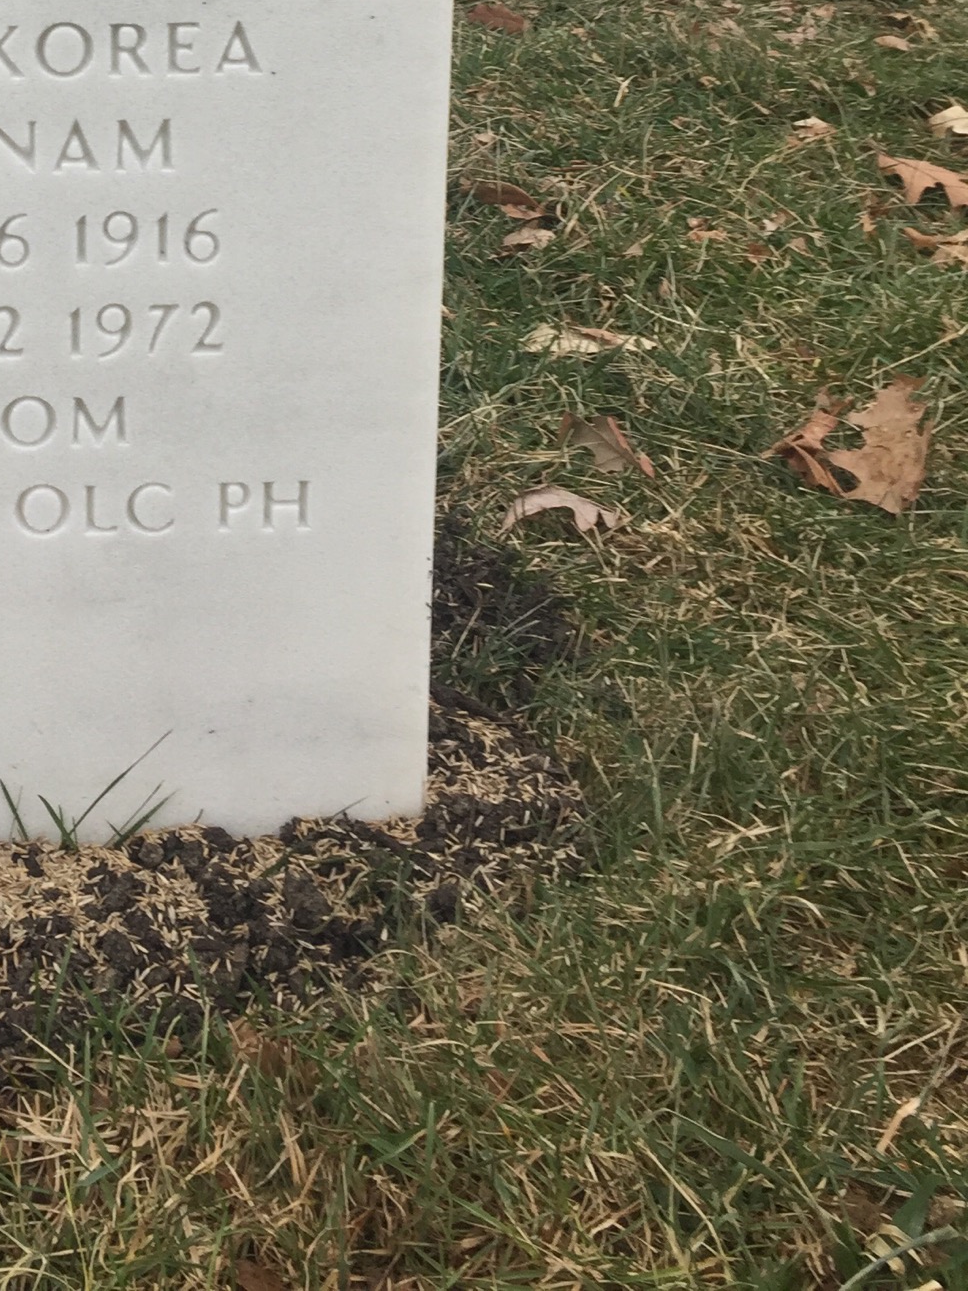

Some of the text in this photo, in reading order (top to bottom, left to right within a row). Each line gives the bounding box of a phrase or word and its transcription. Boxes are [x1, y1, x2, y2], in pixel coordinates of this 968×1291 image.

[75, 209, 221, 266] 1916
[69, 301, 224, 361] 1972
[14, 482, 175, 537] OLC
[217, 480, 312, 533] PH
